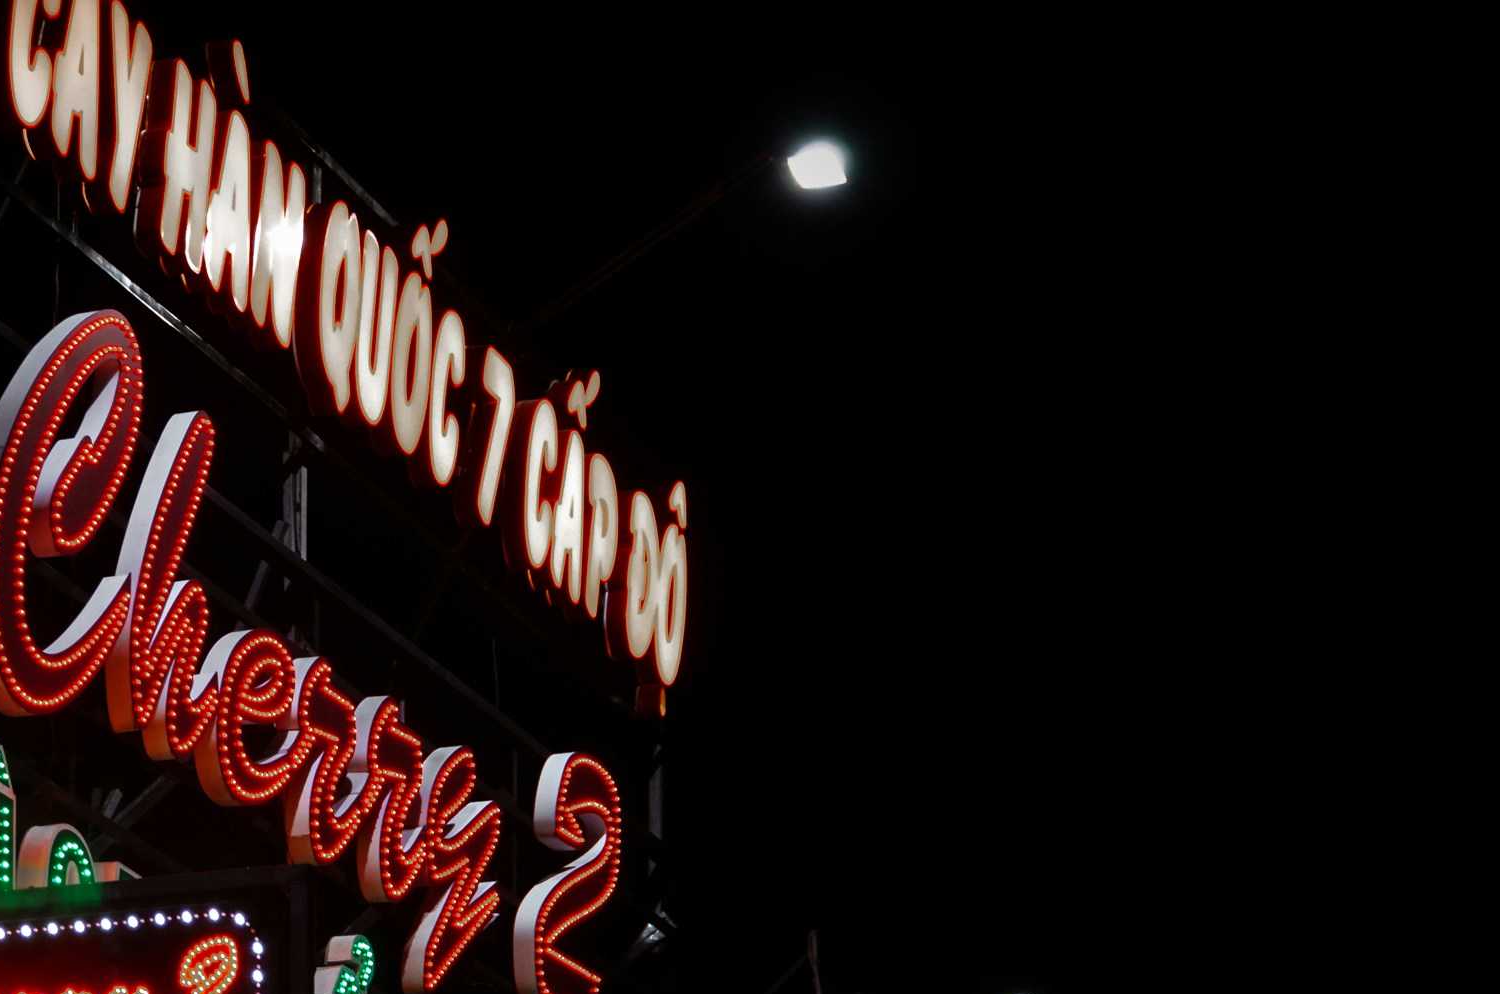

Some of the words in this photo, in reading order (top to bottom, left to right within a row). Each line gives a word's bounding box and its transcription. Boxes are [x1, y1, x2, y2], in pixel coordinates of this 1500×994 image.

[160, 38, 306, 350] HÀN
[319, 218, 466, 486] QUỐC
[477, 345, 516, 527] 7
[524, 370, 620, 620] CẤP
